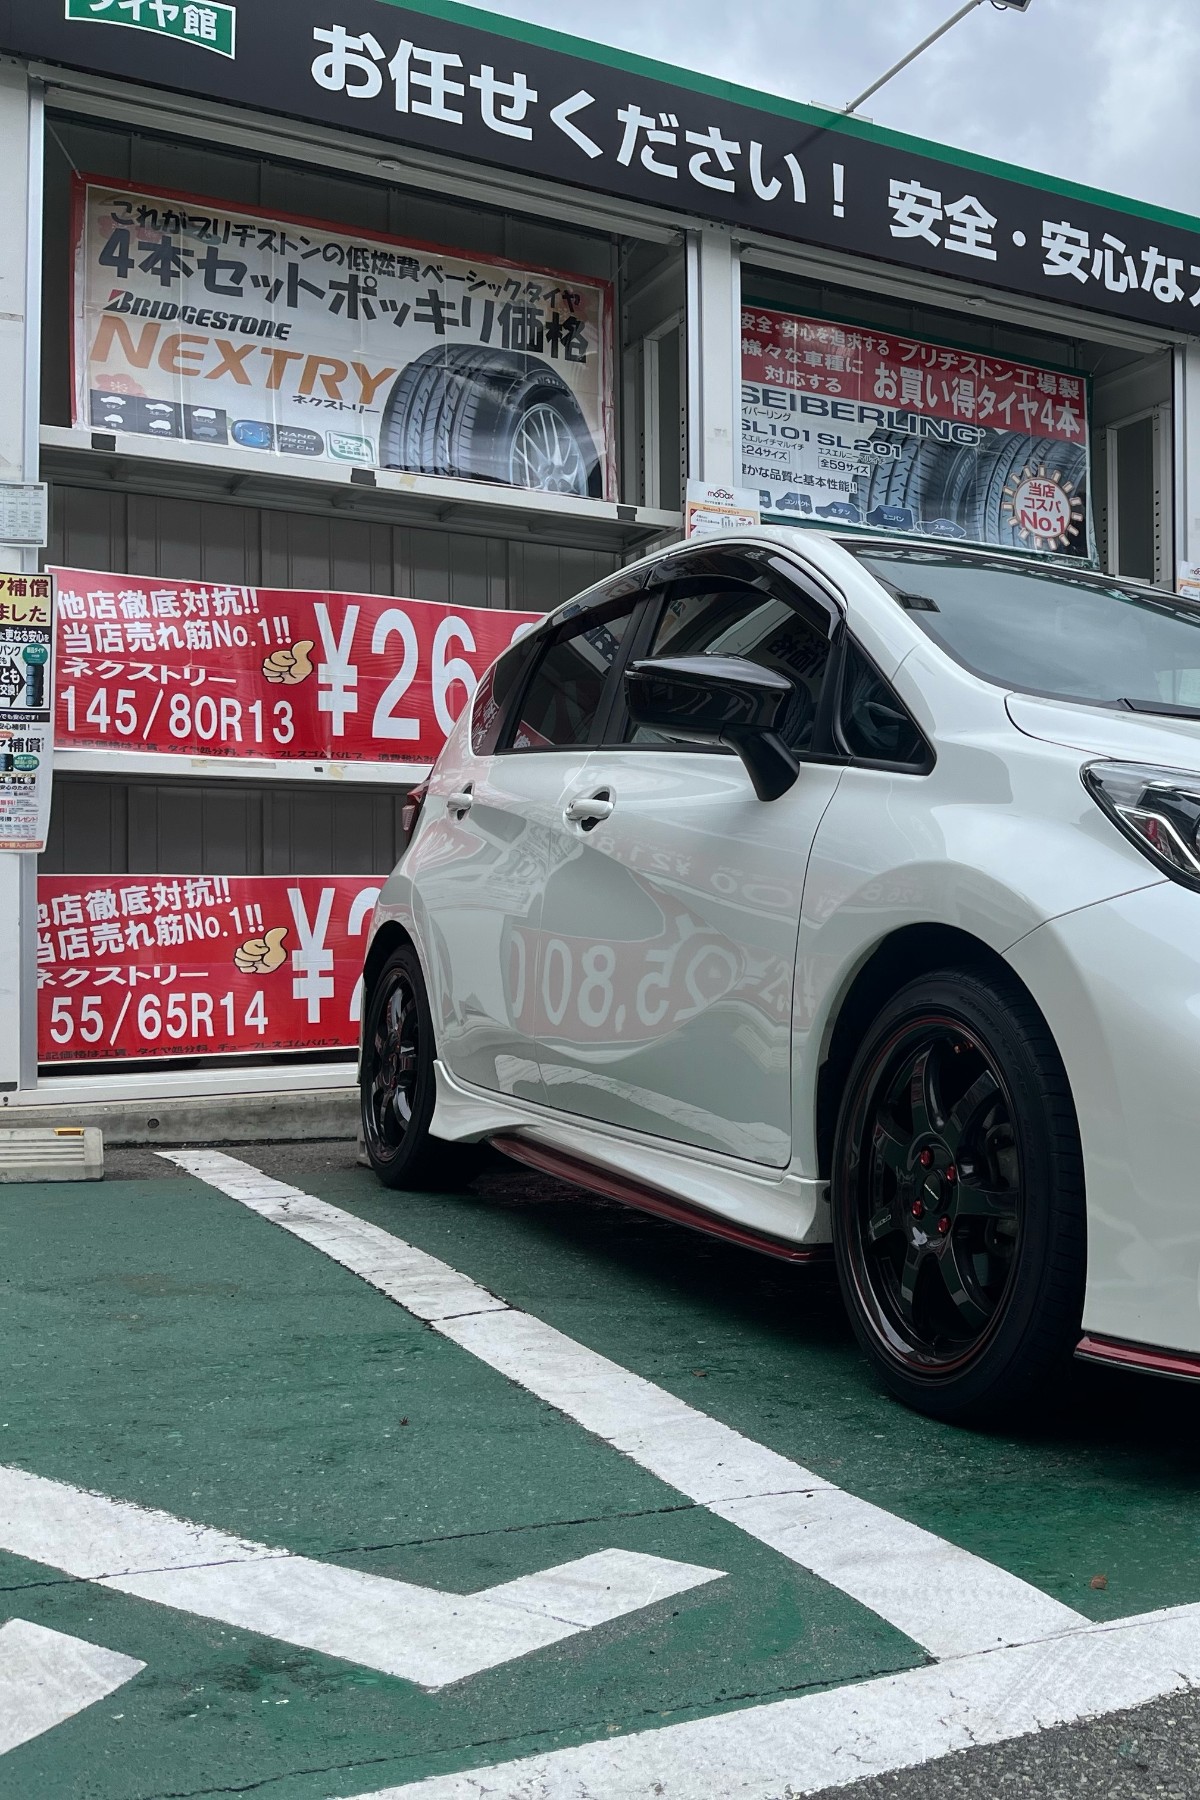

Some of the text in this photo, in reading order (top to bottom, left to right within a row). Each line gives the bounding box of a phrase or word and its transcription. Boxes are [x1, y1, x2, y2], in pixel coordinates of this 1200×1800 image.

[99, 228, 589, 363] 4本セットポッキリ価格
[103, 289, 292, 341] BRIDGESTONE
[741, 312, 890, 355] 安全・安心を追求する
[90, 314, 398, 405] NEXTRY
[741, 338, 863, 374] 様々な車種に
[898, 342, 1080, 399] ブリヂストン工場製
[765, 364, 842, 393] 対応する
[292, 394, 380, 414] ネクストリー
[873, 362, 1081, 438] お買い得タイヤ4本
[741, 386, 979, 446] SEIBERLING
[278, 430, 317, 440] NANO
[817, 433, 902, 460] SL201
[820, 458, 870, 474] 全59サイズ
[785, 498, 811, 507] コンパクト
[1029, 481, 1056, 498] 当店
[831, 507, 851, 516] セダン
[882, 514, 904, 522] ミニバン
[1024, 496, 1061, 513] コスパ
[1020, 509, 1065, 533] No.1
[57, 587, 259, 621] 他店徹底対抗!!
[63, 615, 291, 653] 当店売れ筋No.1!!
[61, 658, 238, 686] ネクストリー
[60, 687, 295, 743] 145/80R13
[38, 965, 209, 989] ネクストリー
[50, 990, 269, 1046] 55/65R14
